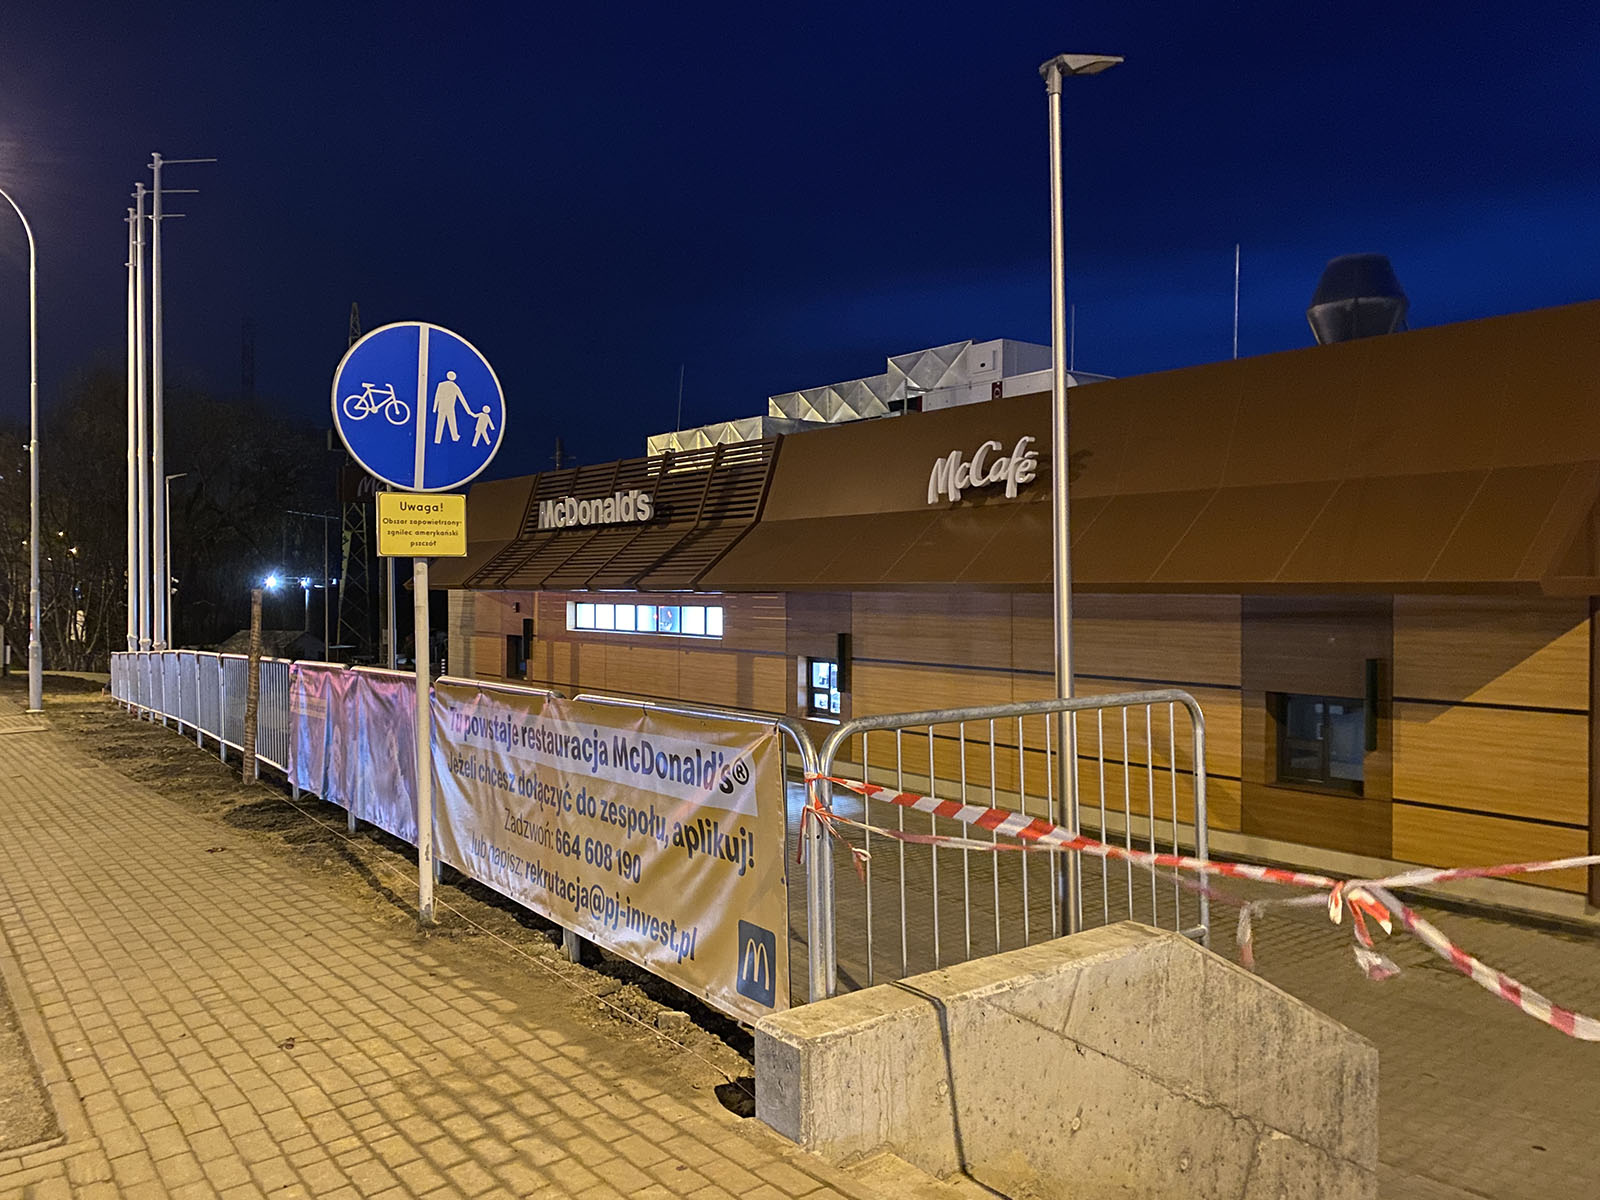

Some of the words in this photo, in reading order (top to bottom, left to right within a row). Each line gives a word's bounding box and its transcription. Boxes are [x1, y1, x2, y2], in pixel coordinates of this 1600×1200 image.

[357, 475, 386, 497] Mc
[928, 436, 1039, 505] McCafé
[382, 517, 408, 525] Obszar
[399, 501, 443, 514] Uwaga!
[538, 490, 654, 529] McDonald's
[387, 529, 413, 537] zgnilec
[414, 529, 458, 538] amerykański
[410, 540, 437, 548] pszczół
[450, 706, 463, 733] Tu
[464, 714, 519, 752] powstaje
[521, 725, 609, 773] restauracja
[447, 752, 477, 781] Jeżeli
[478, 762, 516, 793] chcesz
[517, 769, 573, 817] dołączyć
[576, 786, 597, 819] do
[600, 799, 670, 849] zespołu,
[672, 818, 755, 877] aplikuj!
[503, 807, 554, 850] Zadzwoń:
[555, 828, 582, 861] 664
[585, 837, 613, 872] 608
[616, 849, 642, 884] 190
[470, 831, 487, 859] lub
[488, 843, 524, 877] napisz:
[525, 859, 698, 965] rekrutacja@pj-invest.pl
